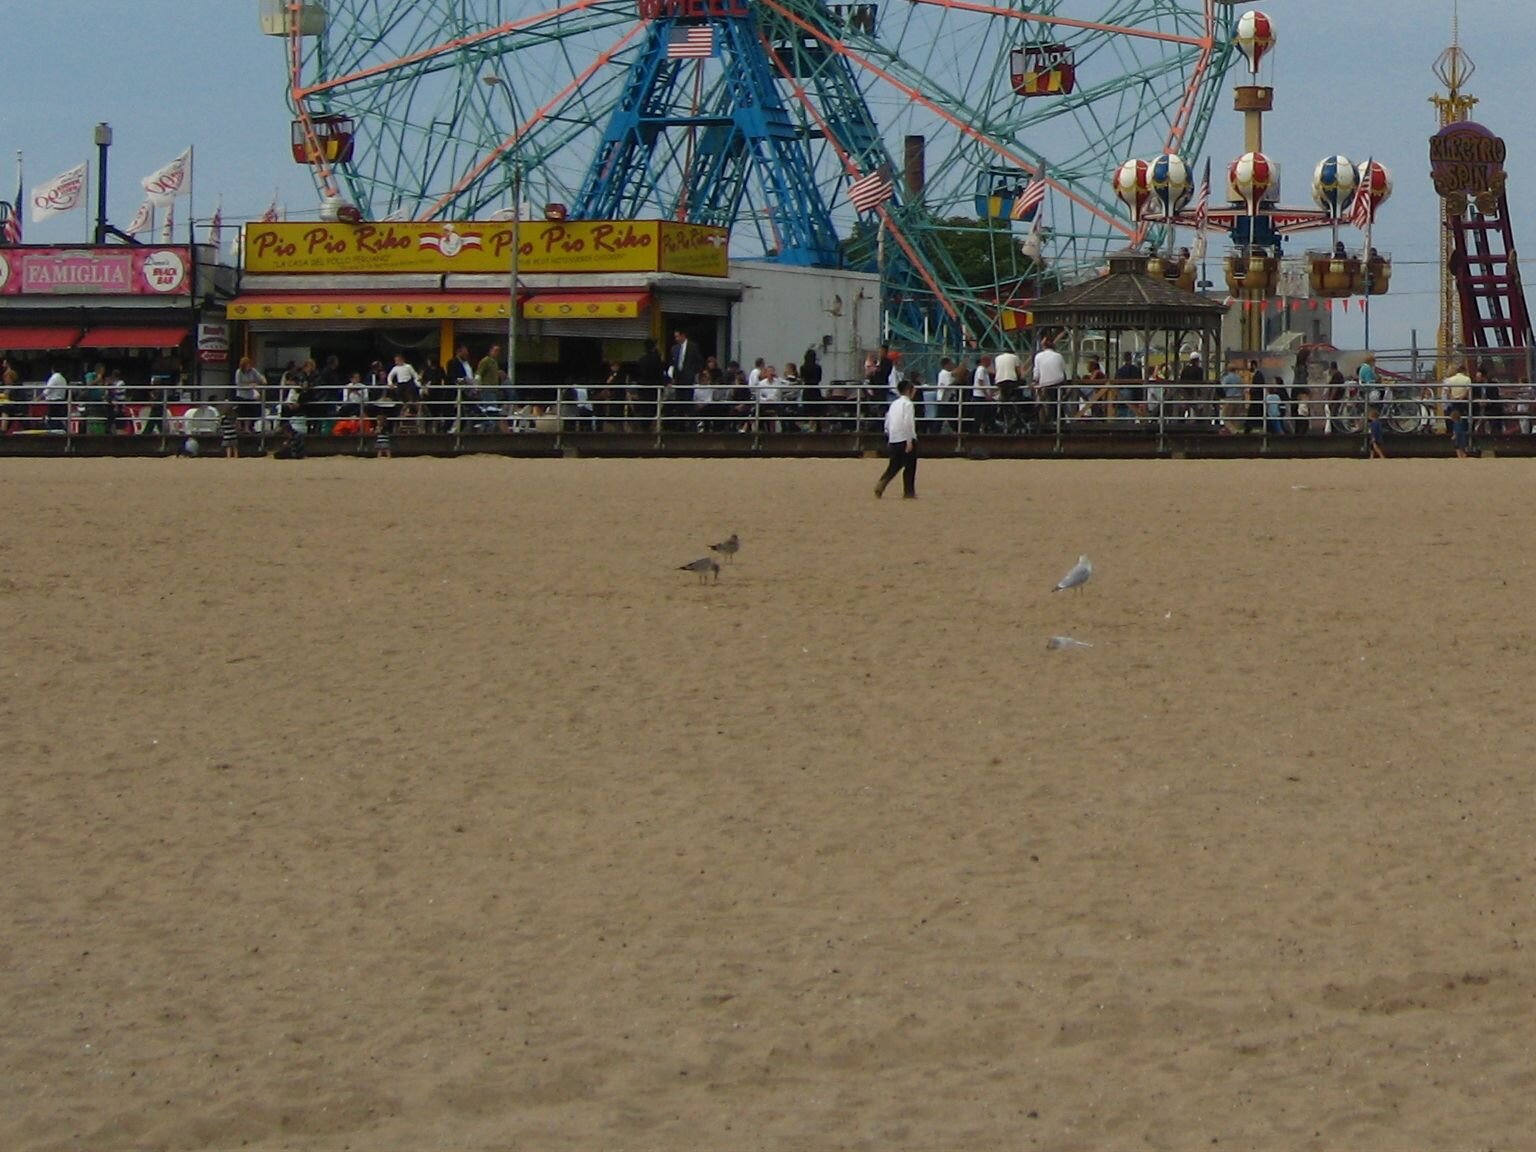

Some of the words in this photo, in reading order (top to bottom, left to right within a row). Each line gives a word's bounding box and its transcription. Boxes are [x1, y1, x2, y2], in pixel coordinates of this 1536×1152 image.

[1430, 136, 1504, 161] ELECTRO
[1448, 163, 1488, 190] SPIN
[253, 231, 296, 258] Pio
[303, 227, 346, 255] Pio
[353, 224, 410, 253] Riko
[489, 230, 533, 257] Po
[540, 226, 583, 253] Pio
[591, 224, 651, 252] Riko
[28, 264, 124, 284] FAMIGLIA
[153, 268, 177, 276] SNACK
[157, 277, 173, 285] BAR
